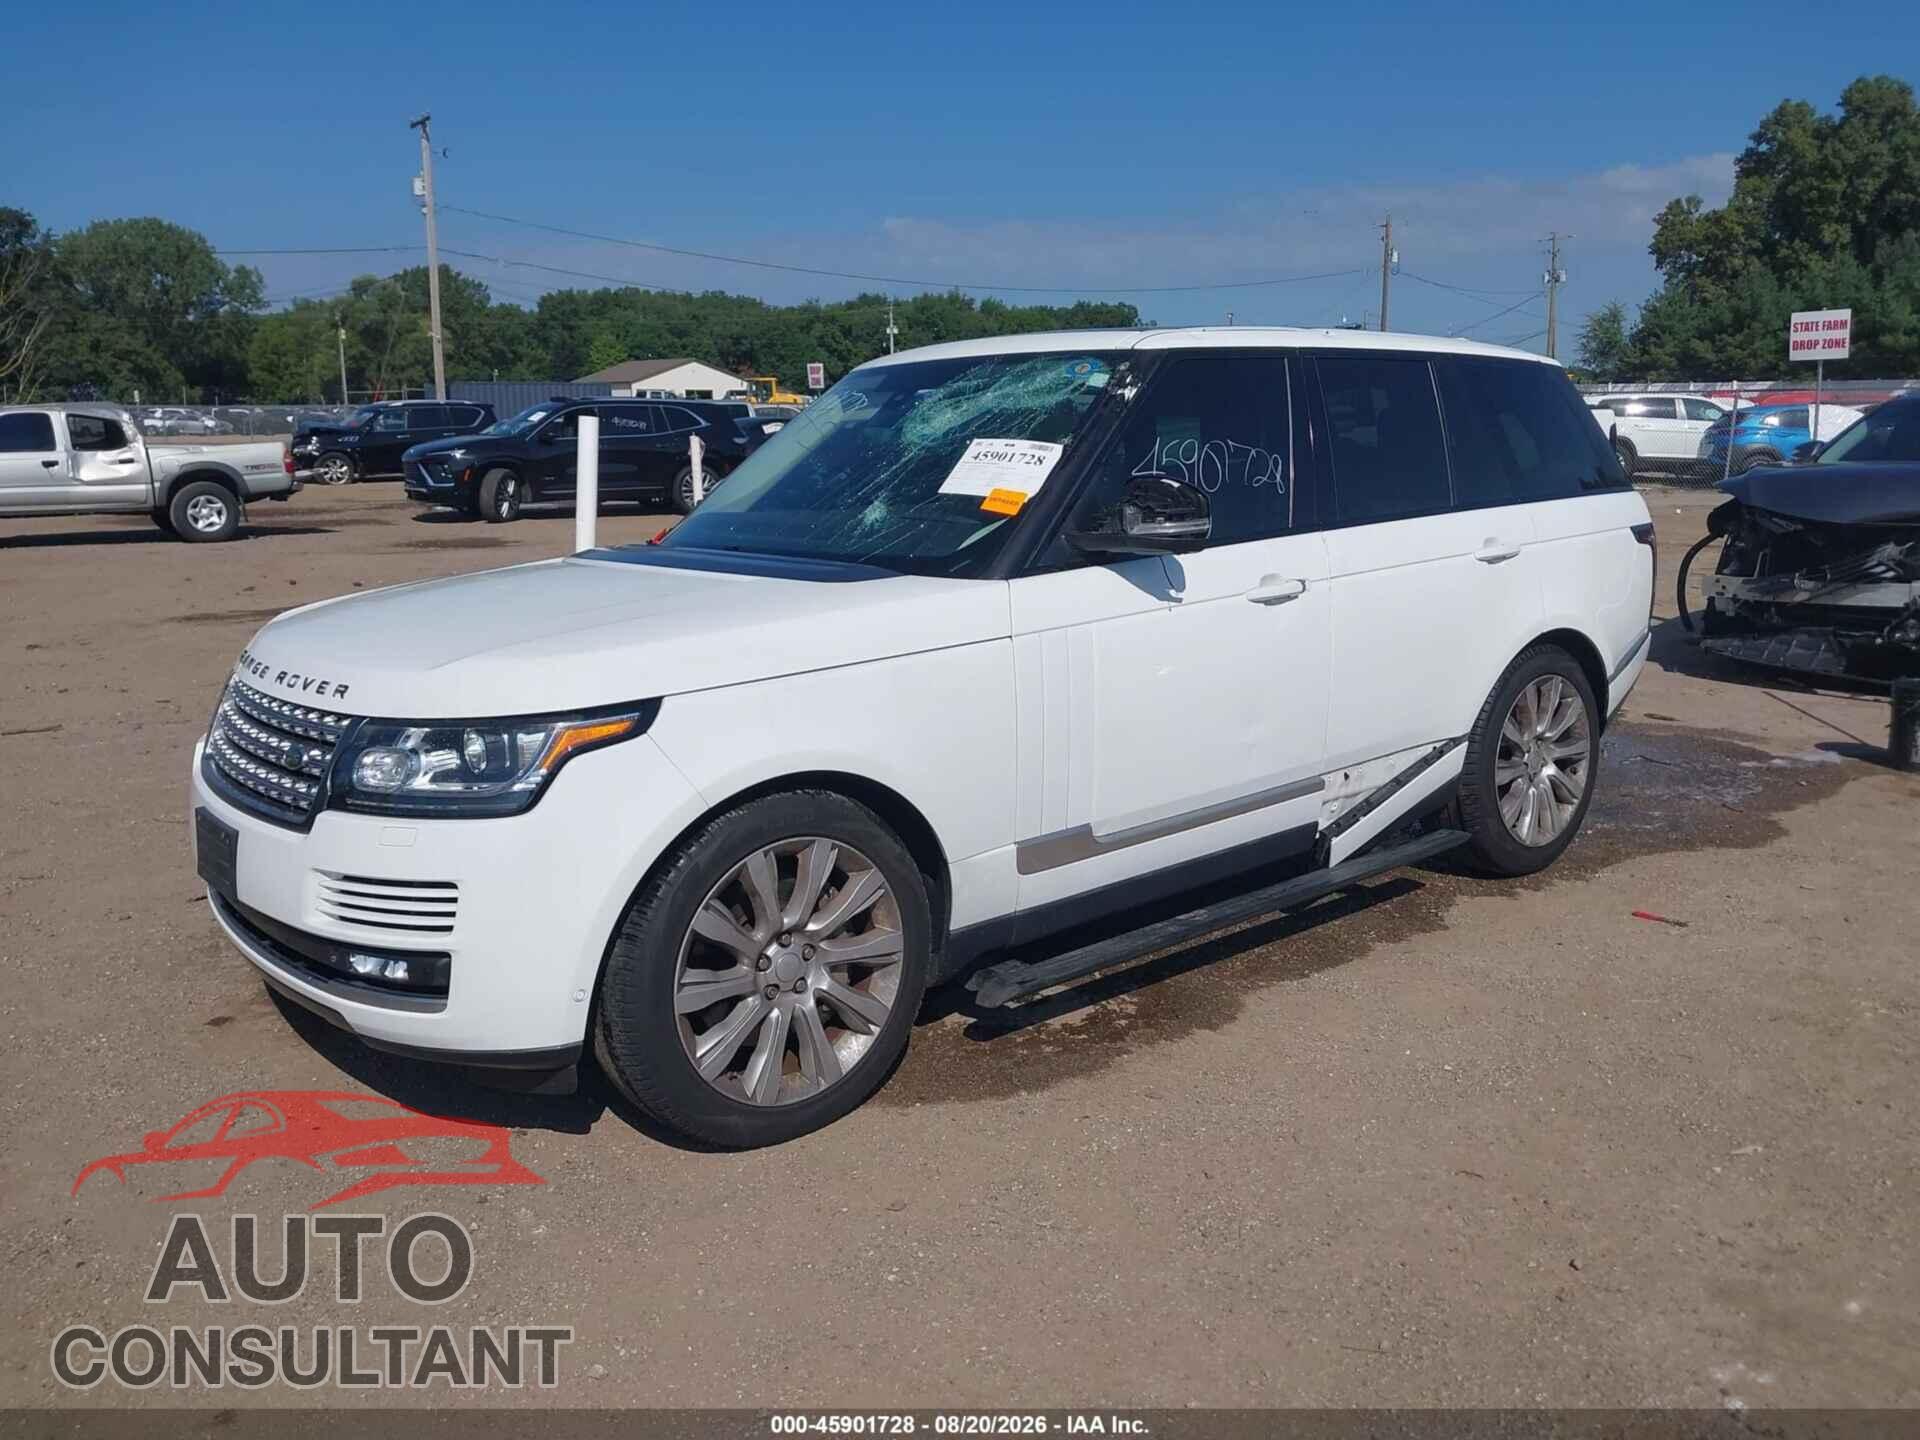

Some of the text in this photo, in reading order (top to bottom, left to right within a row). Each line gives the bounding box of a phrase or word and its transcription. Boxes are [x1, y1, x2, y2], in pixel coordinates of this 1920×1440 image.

[1793, 319, 1848, 333] STATE FARM
[1792, 337, 1847, 351] DROP ZONE
[971, 450, 1046, 466] 45901728
[1131, 436, 1285, 494] 45901728
[275, 670, 349, 700] ROVER
